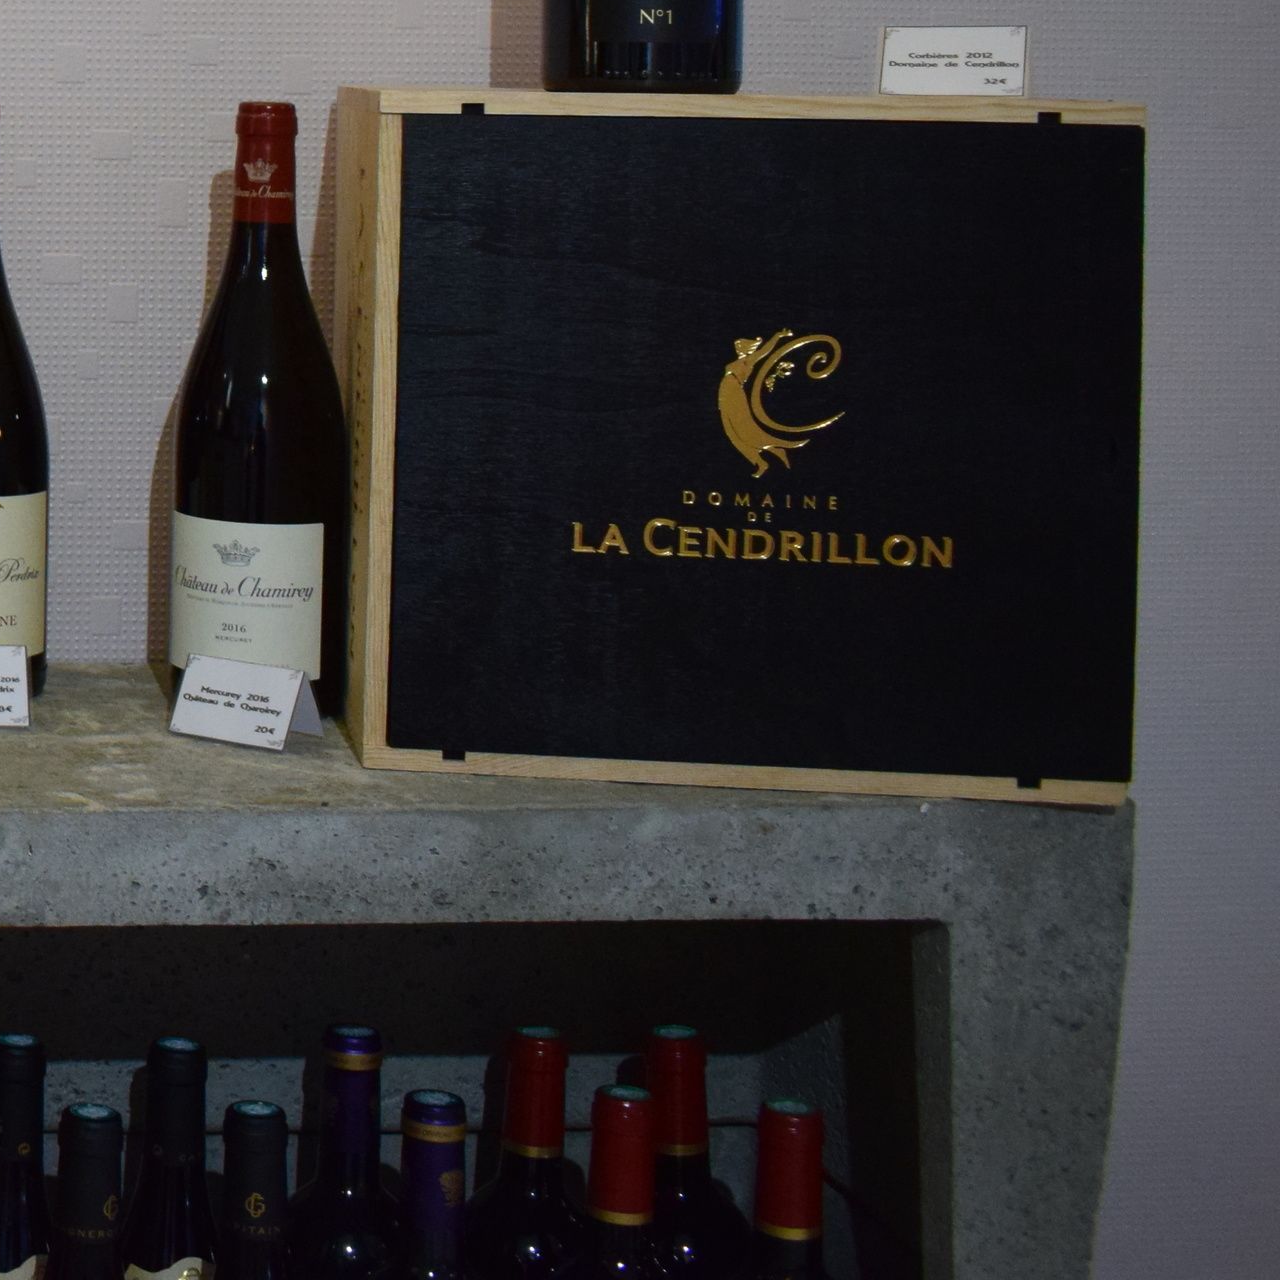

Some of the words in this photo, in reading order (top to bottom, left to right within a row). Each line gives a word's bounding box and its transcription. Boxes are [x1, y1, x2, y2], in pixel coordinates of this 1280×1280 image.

[682, 490, 839, 510] DOMAINE
[748, 512, 772, 522] DE
[571, 521, 630, 555] LA
[642, 518, 954, 568] CENDRILLON
[175, 565, 218, 593] Château
[220, 581, 234, 595] de
[238, 576, 314, 602] Chamirey
[221, 622, 247, 633] 2016
[201, 686, 242, 699] Mercurey
